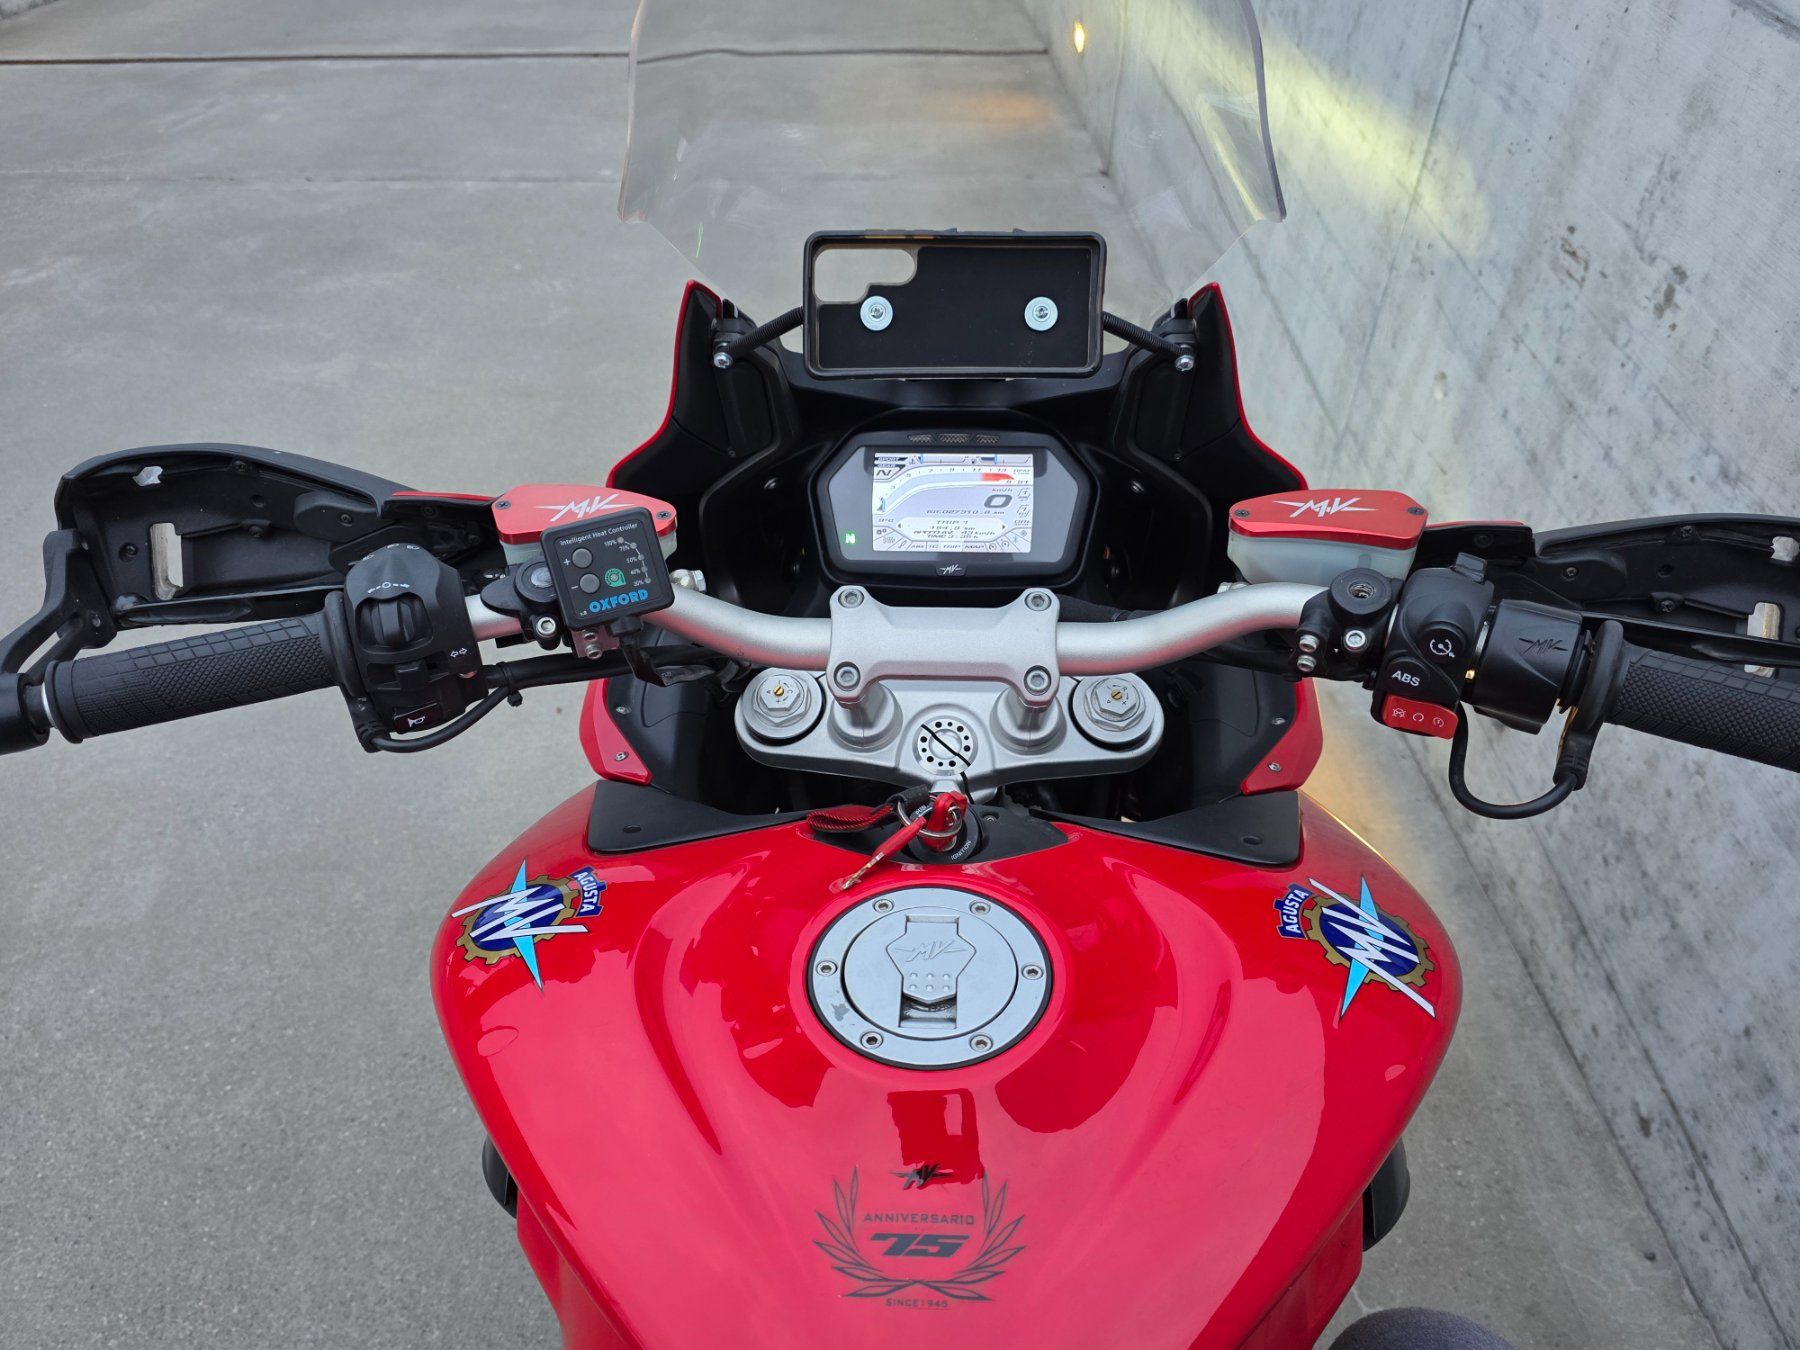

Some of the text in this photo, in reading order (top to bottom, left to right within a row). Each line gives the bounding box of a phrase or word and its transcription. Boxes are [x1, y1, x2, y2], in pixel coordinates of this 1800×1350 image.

[984, 494, 1012, 508] 0
[560, 522, 638, 546] Intelligent Heat Controller
[845, 533, 856, 544] N
[589, 588, 649, 613] OXFORD
[1392, 670, 1421, 687] ABS
[950, 840, 972, 860] IGNITION
[573, 871, 599, 913] AGUSTA
[1282, 889, 1310, 934] AGUSTA
[863, 1212, 975, 1225] ANNIVERSARIO
[870, 1232, 970, 1258] 75
[885, 1297, 918, 1307] SINCE
